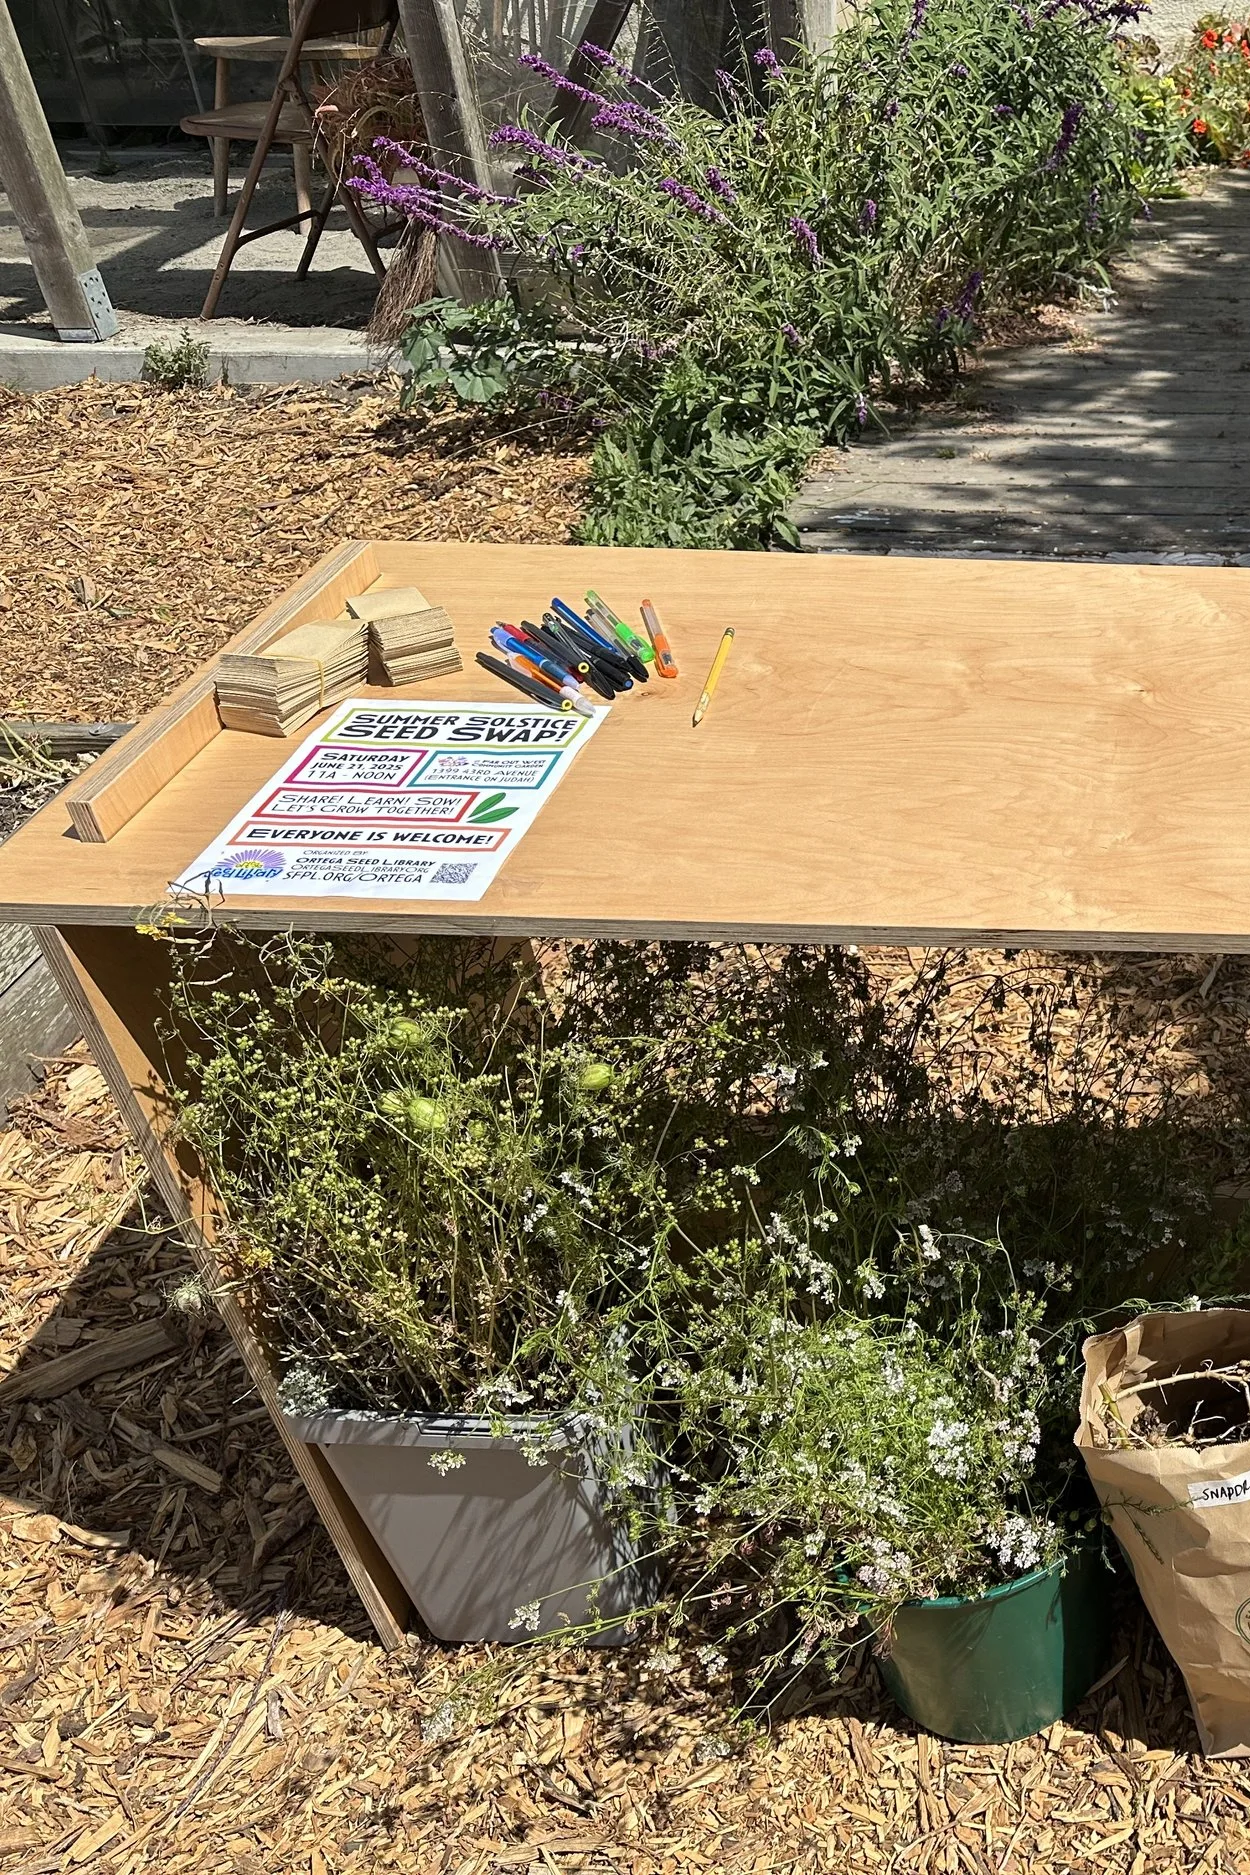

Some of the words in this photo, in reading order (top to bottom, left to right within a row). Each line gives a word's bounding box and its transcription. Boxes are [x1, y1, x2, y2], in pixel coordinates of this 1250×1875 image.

[352, 713, 461, 726] SUMMER
[465, 716, 579, 730] SOLSTICE
[338, 725, 438, 740] SEED
[447, 727, 570, 742] SWAP!
[321, 752, 410, 763] SATURDAY
[312, 762, 344, 771] JUNE
[349, 762, 366, 772] 21,
[370, 763, 403, 772] 2025
[306, 769, 336, 780] 11A
[353, 770, 397, 780] NOON
[278, 794, 344, 804] SHARE!
[348, 796, 411, 805] LEARN!
[414, 797, 462, 806] SOW!
[272, 804, 316, 812] LET'S
[319, 804, 371, 814] GROW
[376, 806, 454, 816] TOGETHER!
[247, 828, 364, 841] EVERYONE
[366, 832, 388, 842] IS
[392, 832, 494, 845] WELCOME!
[296, 857, 343, 865] ORTEGA
[347, 858, 380, 866] SEED
[382, 858, 437, 868] LIBRARY
[283, 870, 422, 884] SFPL.ORG/ORTEGA
